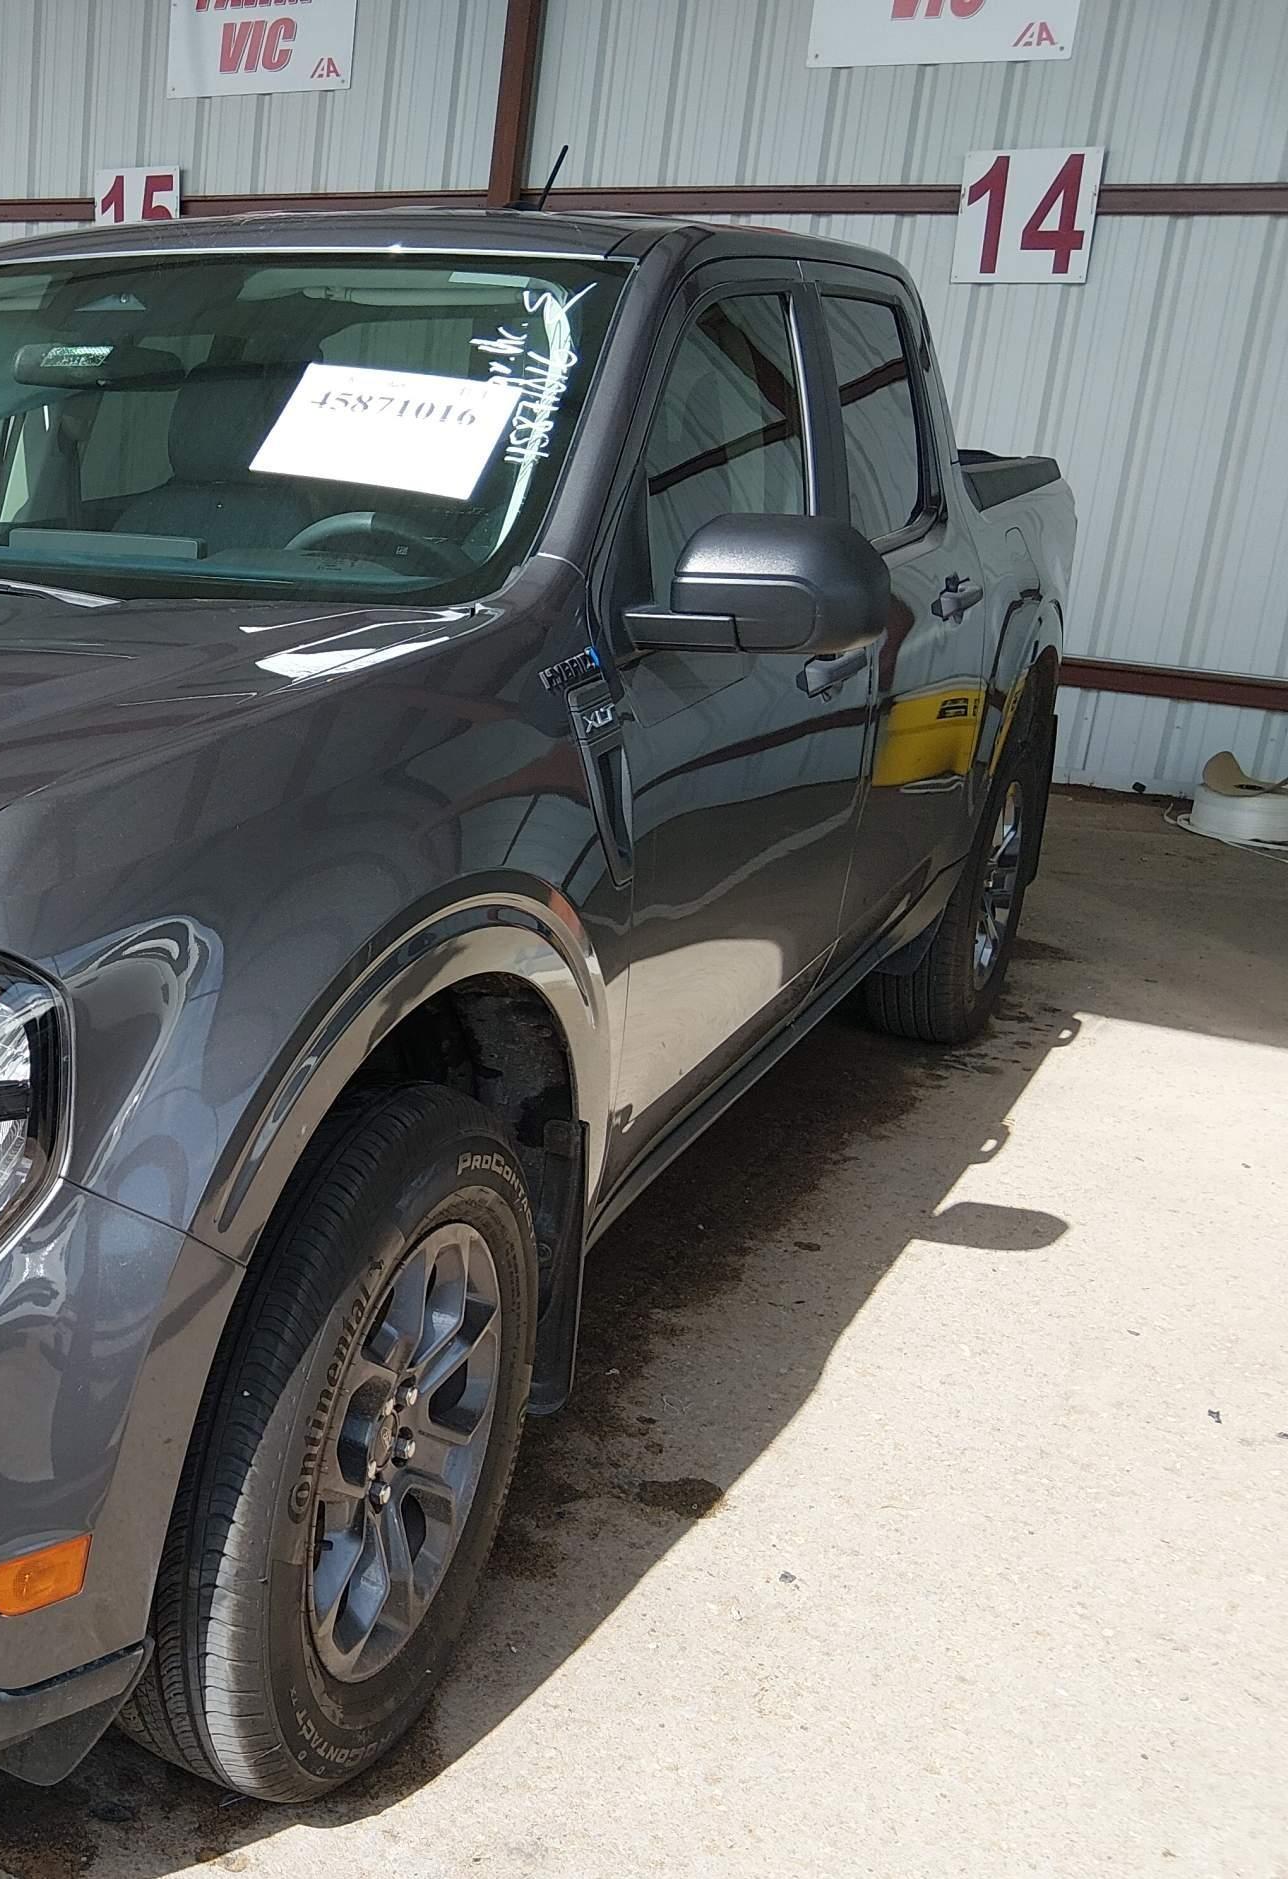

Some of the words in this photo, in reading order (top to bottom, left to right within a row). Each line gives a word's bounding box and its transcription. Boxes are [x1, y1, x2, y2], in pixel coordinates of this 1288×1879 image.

[219, 17, 298, 74] VIC
[967, 153, 1086, 274] 14
[311, 391, 477, 426] 45871016
[582, 704, 615, 734] XLT
[287, 1284, 371, 1524] Continental
